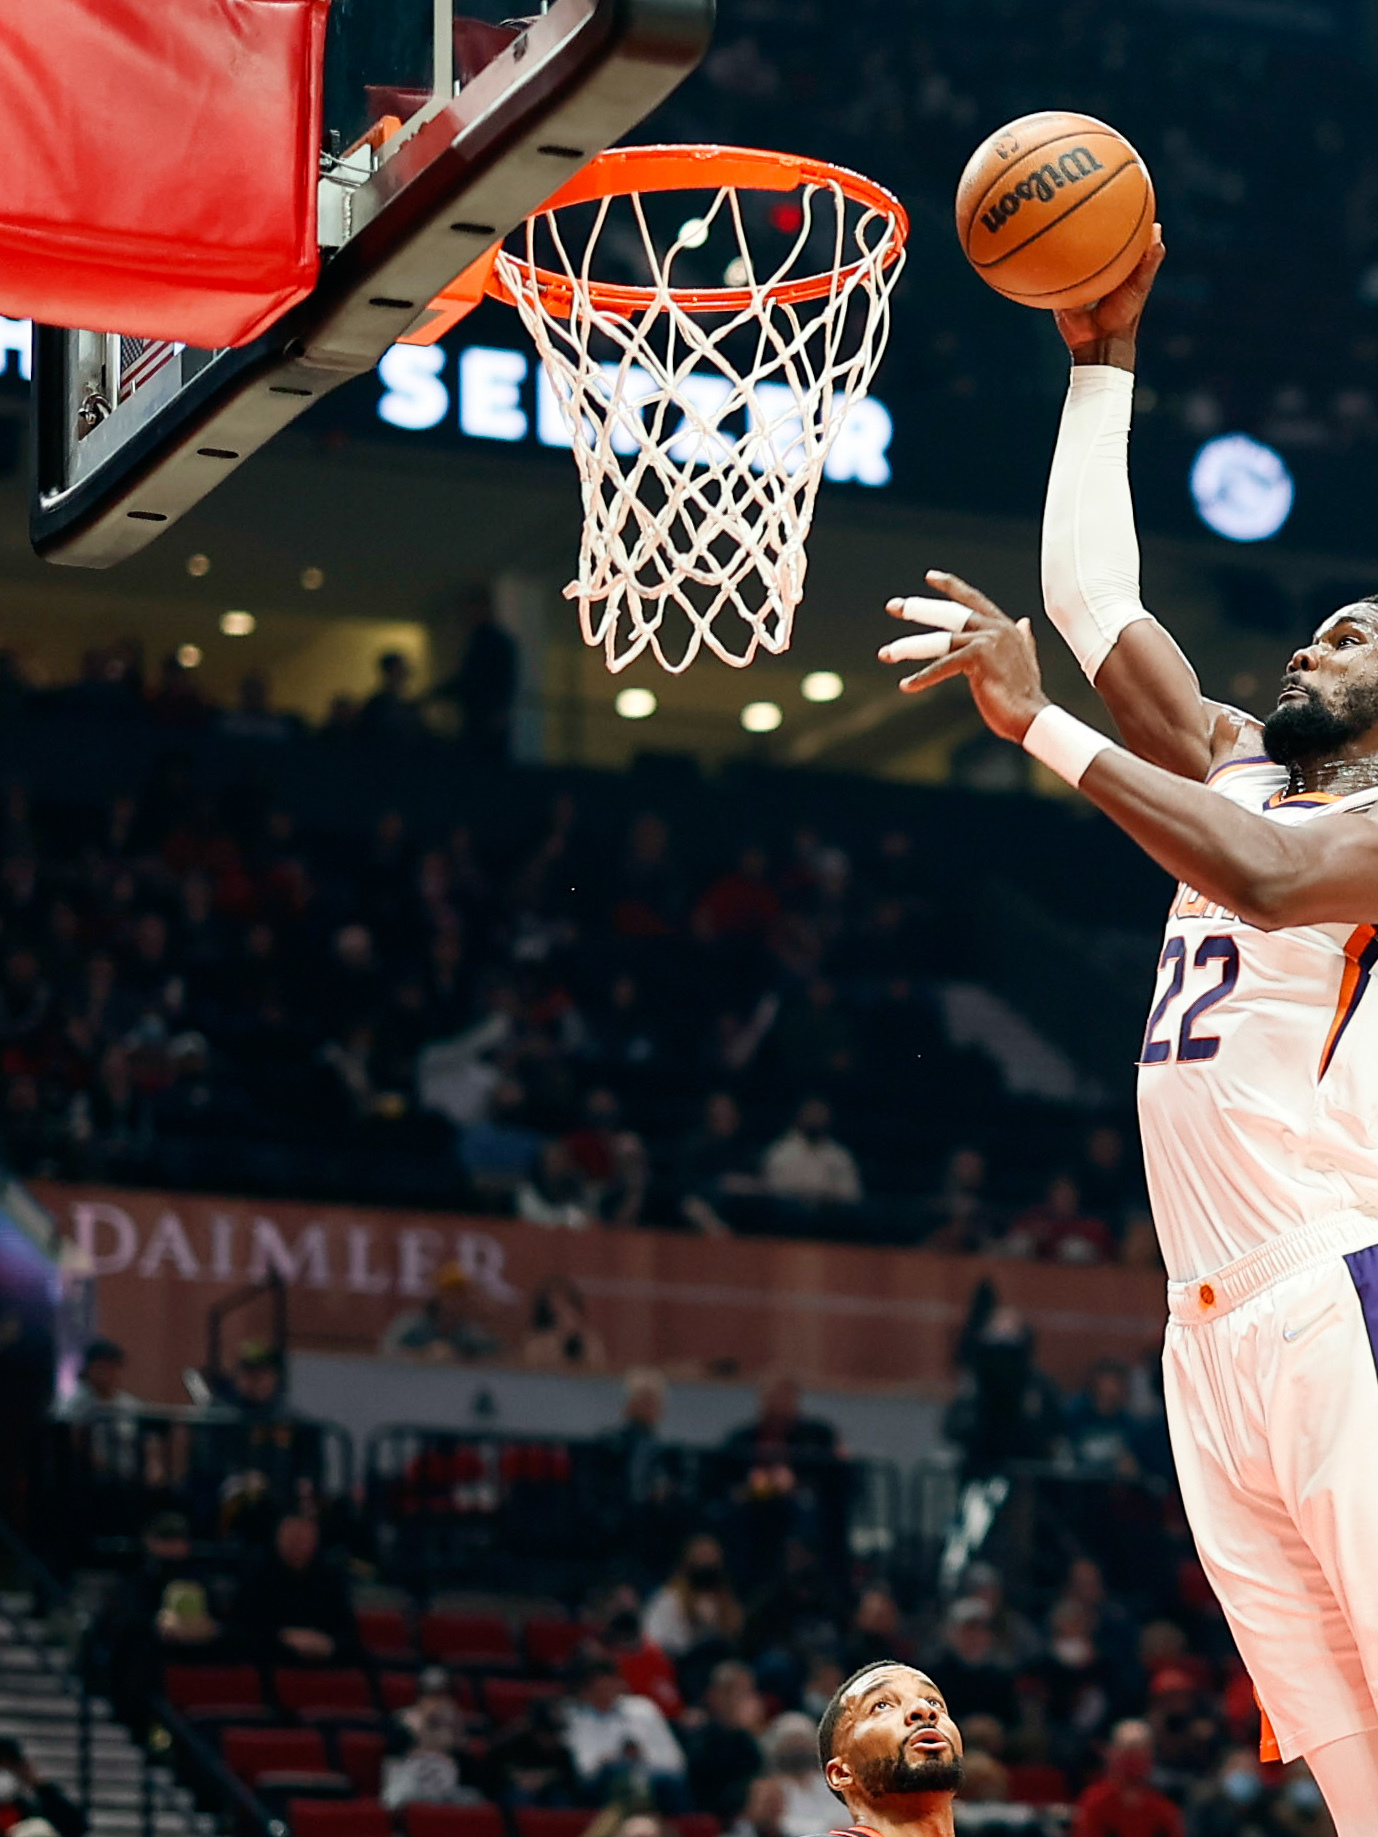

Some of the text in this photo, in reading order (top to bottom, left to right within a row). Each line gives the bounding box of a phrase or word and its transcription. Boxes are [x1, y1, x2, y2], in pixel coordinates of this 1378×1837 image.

[980, 146, 1104, 233] Wilson
[1141, 934, 1240, 1065] 22
[71, 1203, 521, 1301] DAIMLER
